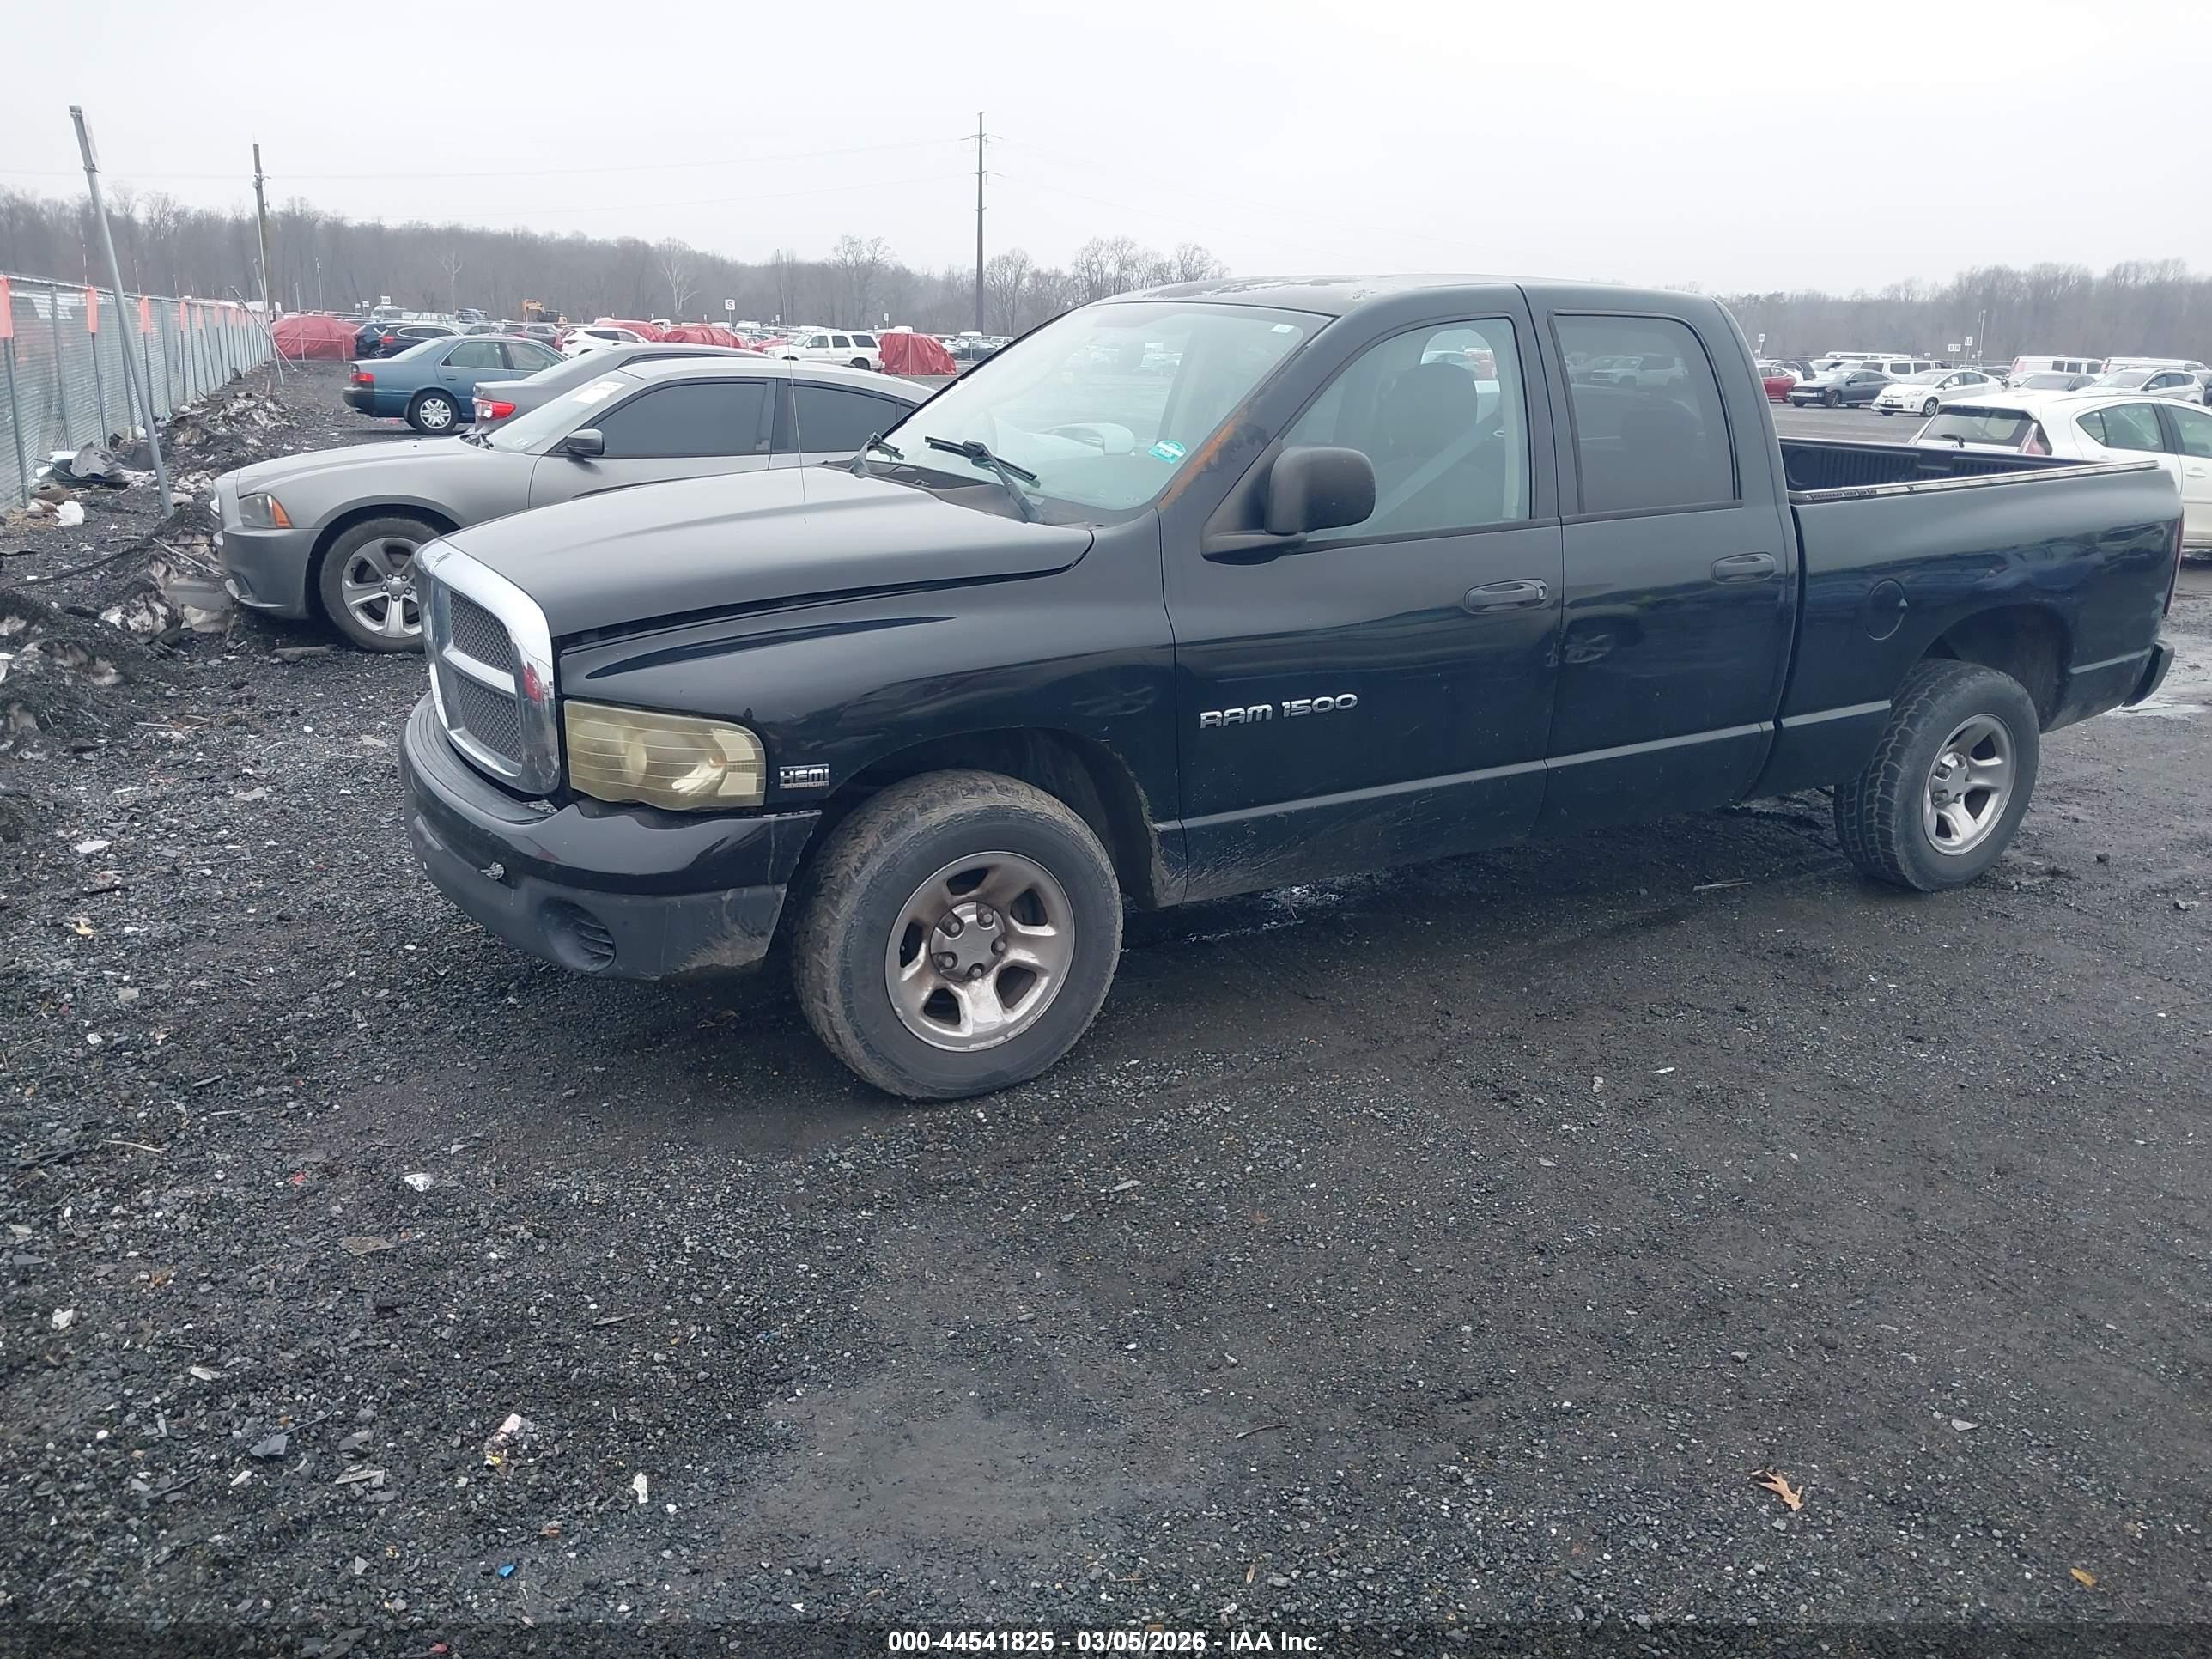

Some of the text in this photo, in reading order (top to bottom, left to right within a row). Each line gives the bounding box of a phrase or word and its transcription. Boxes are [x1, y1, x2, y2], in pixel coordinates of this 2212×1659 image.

[1199, 693, 1358, 729] RAM 1500
[780, 768, 830, 785] HEMI
